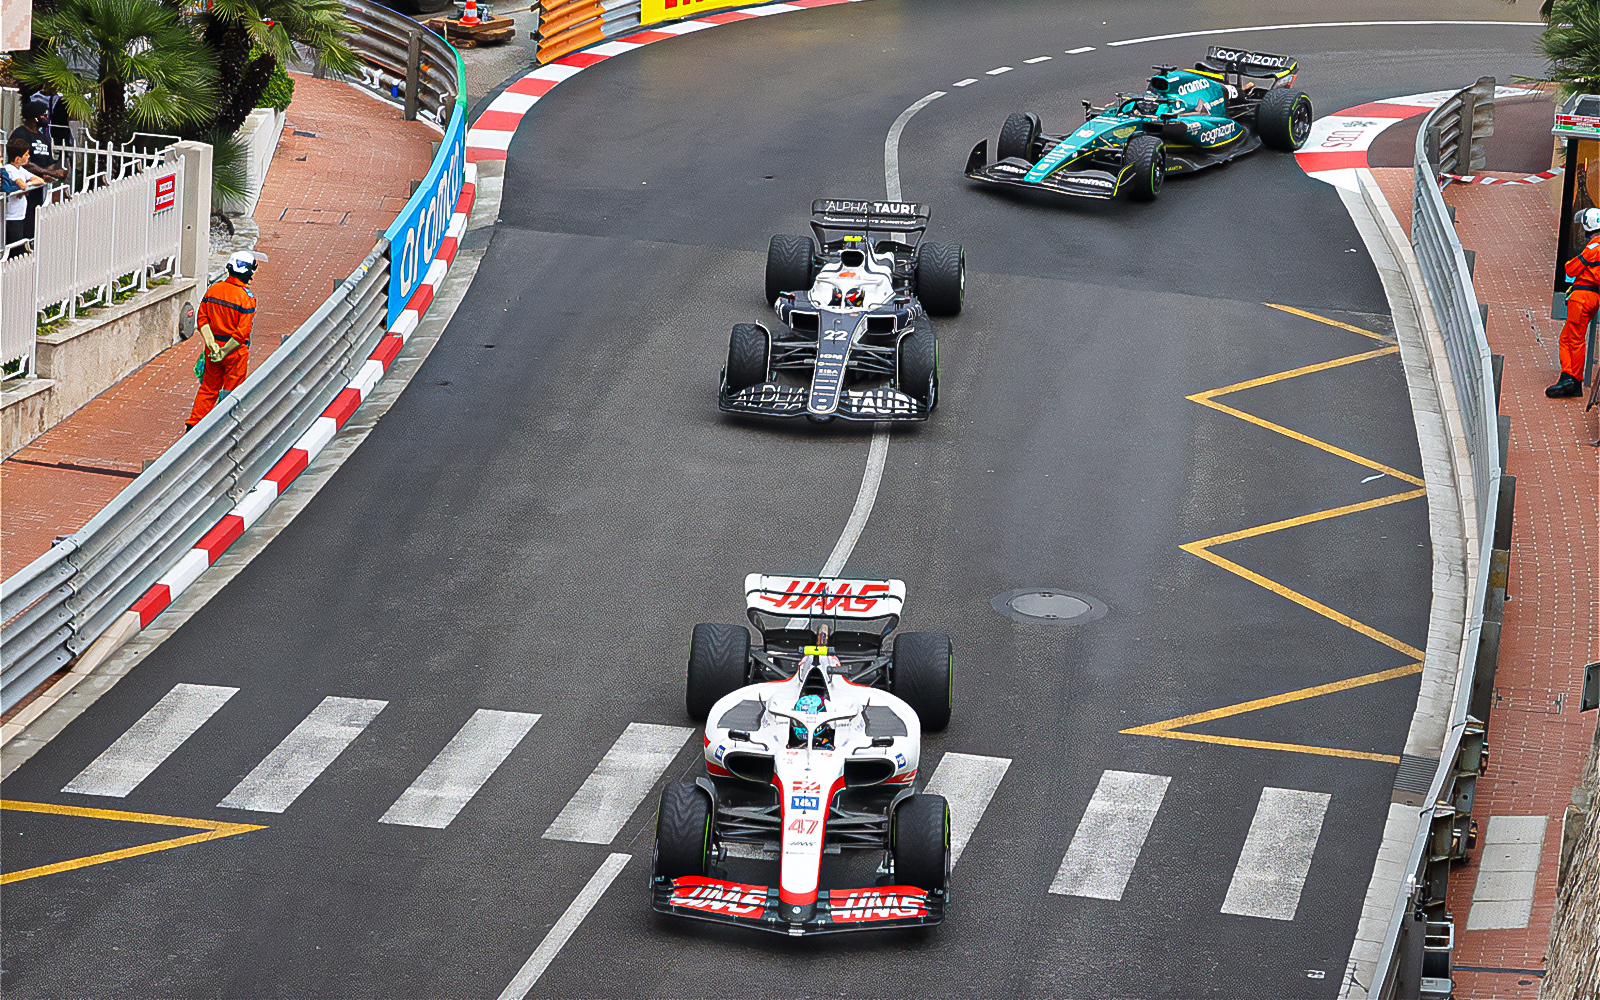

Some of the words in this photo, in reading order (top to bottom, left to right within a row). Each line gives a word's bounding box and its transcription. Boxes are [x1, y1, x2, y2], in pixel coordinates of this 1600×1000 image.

[1178, 79, 1210, 96] aramco
[1200, 121, 1236, 144] cognizant
[1321, 130, 1364, 148] UBS
[826, 200, 868, 212] ALPHA
[873, 202, 917, 215] TAURI
[400, 141, 460, 298] aramco
[823, 330, 848, 341] 22
[760, 580, 890, 612] HAAS
[788, 818, 819, 835] 47
[830, 892, 926, 919] HAAS
